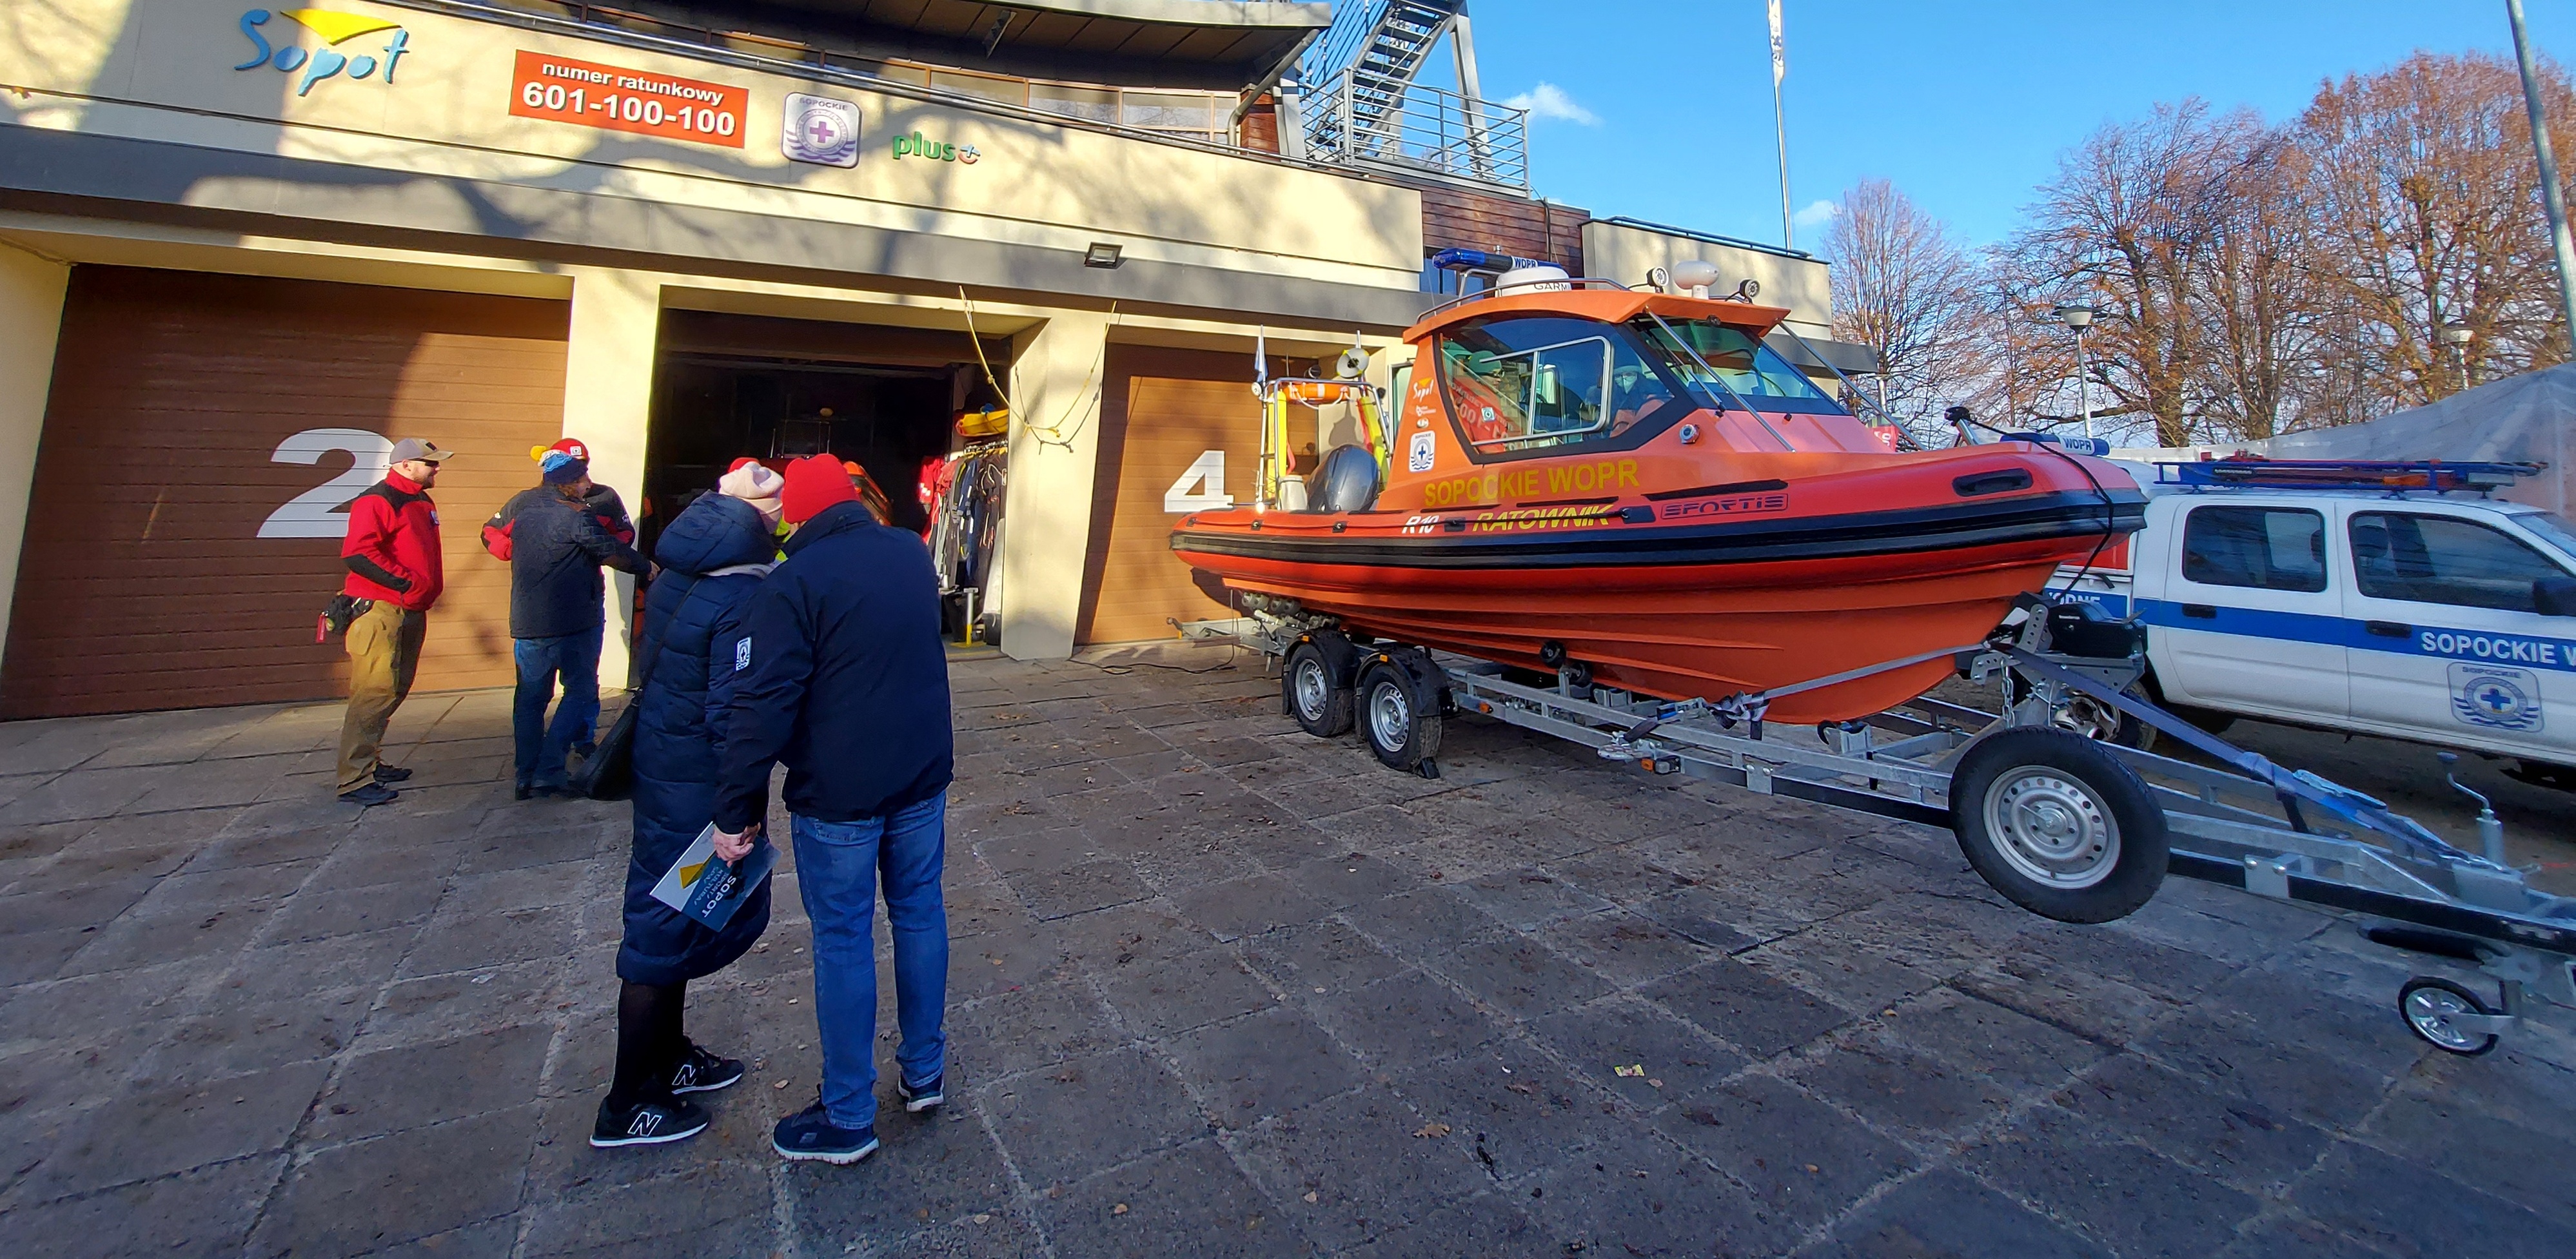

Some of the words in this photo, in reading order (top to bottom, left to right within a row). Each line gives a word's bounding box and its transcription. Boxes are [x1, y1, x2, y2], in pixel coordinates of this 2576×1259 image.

[234, 9, 410, 97] Sopot
[542, 63, 613, 86] numer
[617, 73, 724, 106] ratunkowy
[522, 81, 736, 137] 601-100-100
[800, 97, 849, 111] SOPOCKIE
[1515, 257, 1537, 269] WOPR
[2063, 438, 2092, 451] WOPR
[257, 428, 395, 538] 2
[1164, 450, 1234, 512] 4
[1424, 469, 1540, 507] SOPOCKIE
[1548, 459, 1640, 494] WOPR
[1402, 515, 1440, 534] R10
[1472, 503, 1615, 532] RATOWNIK
[2421, 631, 2558, 665] SOPOCKIE
[702, 875, 736, 917] SOPOT
[627, 1111, 662, 1137] N
